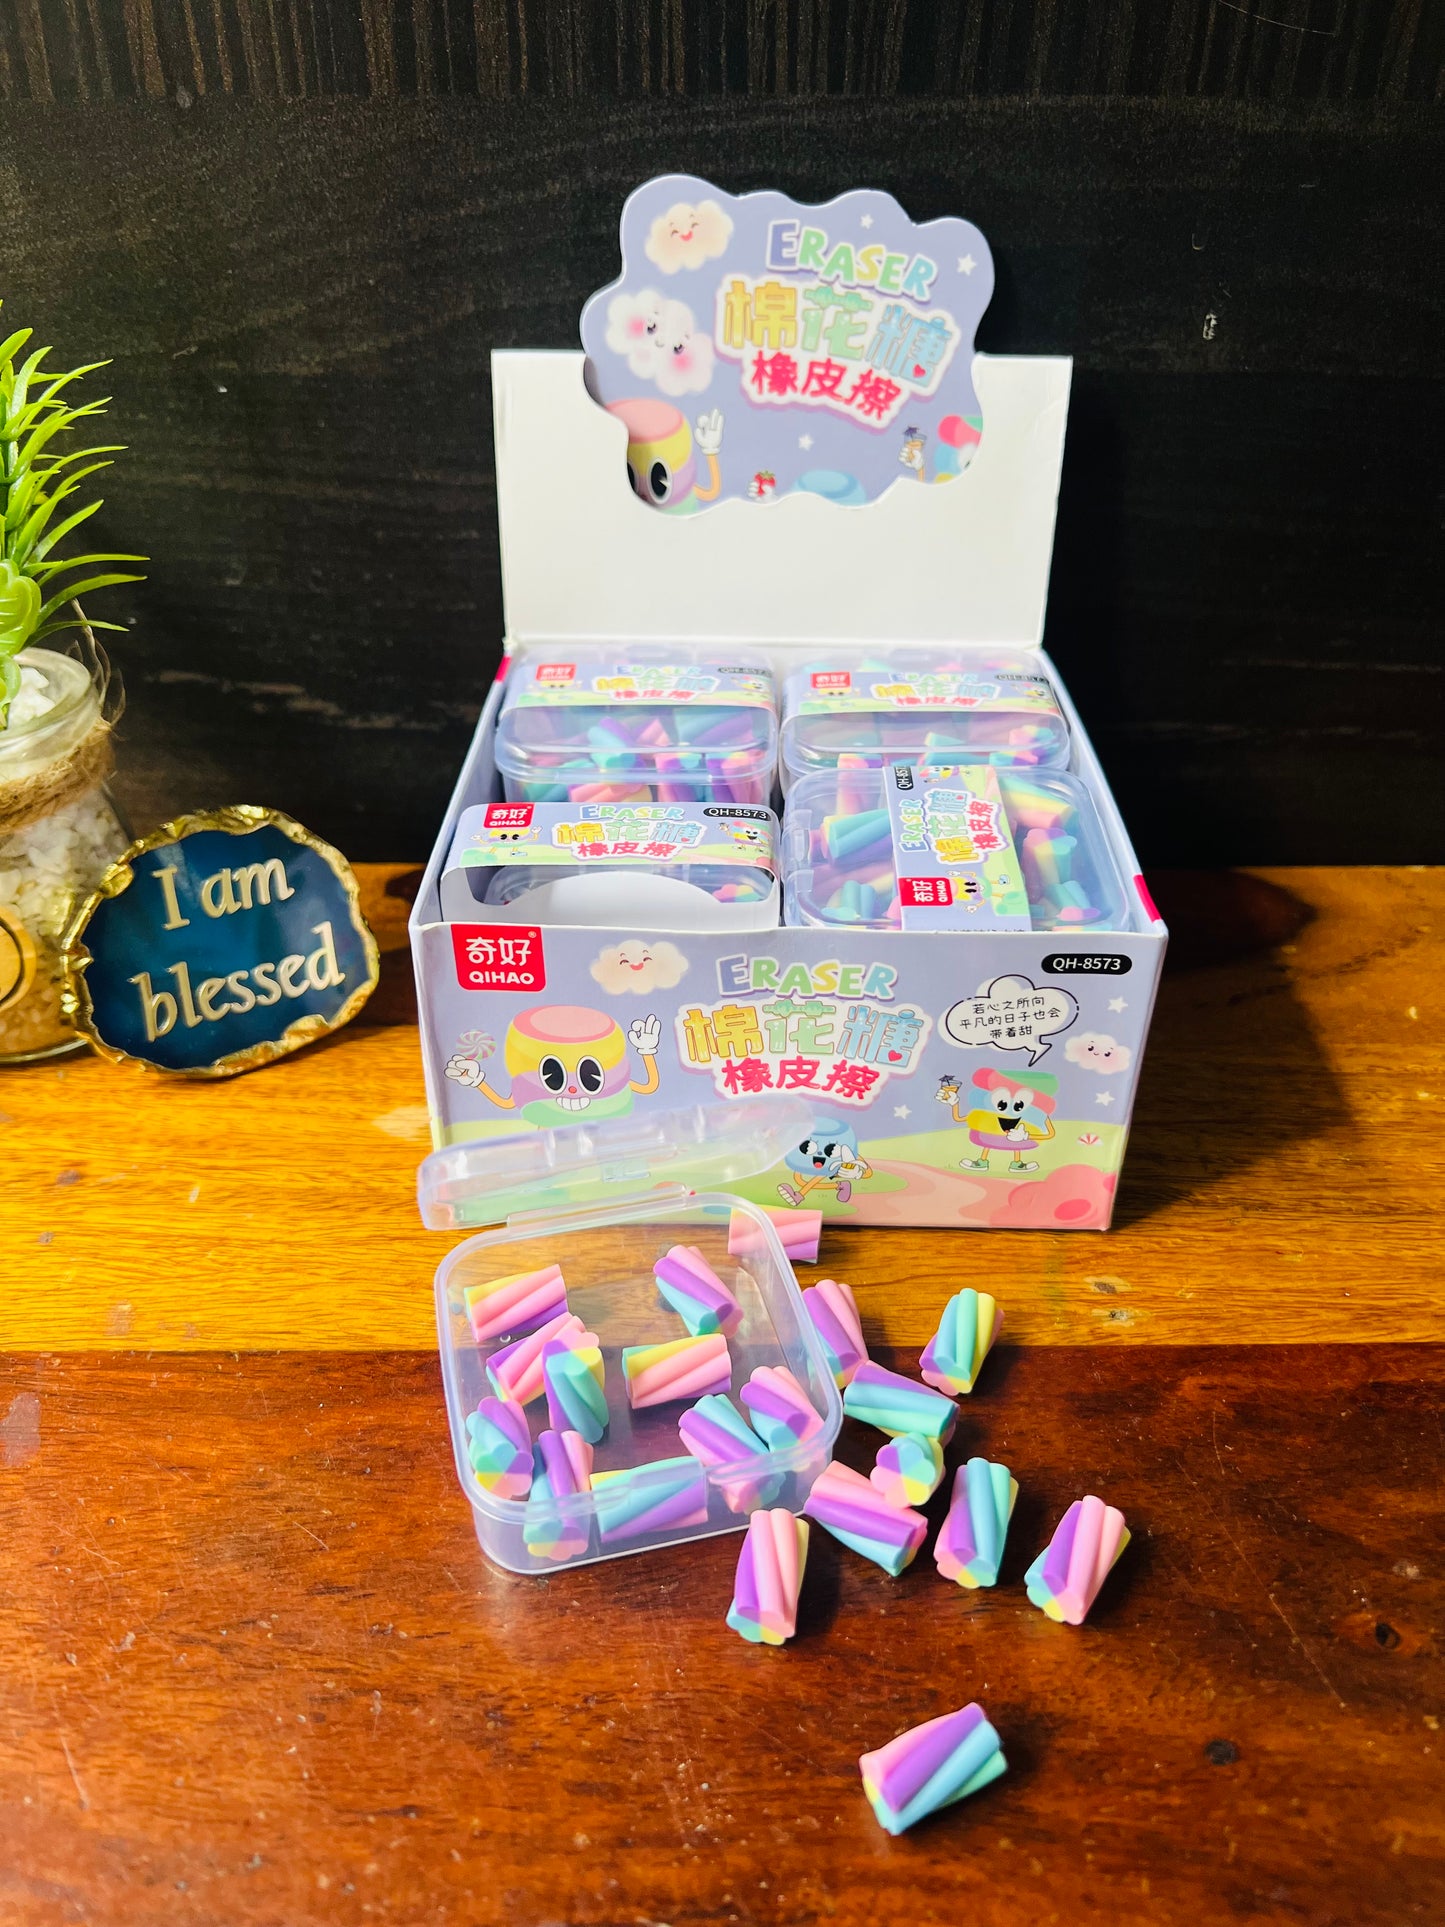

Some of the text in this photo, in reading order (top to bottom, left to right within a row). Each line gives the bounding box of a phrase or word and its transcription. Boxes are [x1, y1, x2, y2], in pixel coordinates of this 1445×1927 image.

[767, 221, 937, 300] ERASER
[723, 280, 955, 388] 棉花糖
[751, 350, 902, 420] 橡皮擦
[492, 809, 528, 820] 奇好
[581, 805, 682, 819] ERASER
[708, 808, 767, 819] QH-8573
[901, 799, 928, 851] ERASER
[928, 790, 979, 862] 棉花糖
[557, 820, 702, 845] 棉花糖
[577, 842, 676, 857] 橡皮擦
[151, 857, 296, 931] I am
[912, 880, 934, 902] 奇好
[936, 880, 948, 902] QIHAO
[465, 936, 532, 967] 奇好
[1052, 957, 1121, 971] QH-8573
[127, 920, 346, 1043] blessed
[469, 970, 535, 985] QIHAO
[717, 955, 896, 998] ERASER
[960, 1007, 1061, 1029] 平凡的日子也会
[683, 998, 925, 1068] 棉花糖
[990, 1025, 1033, 1040] 带着甜
[721, 1055, 881, 1100] 橡皮擦
